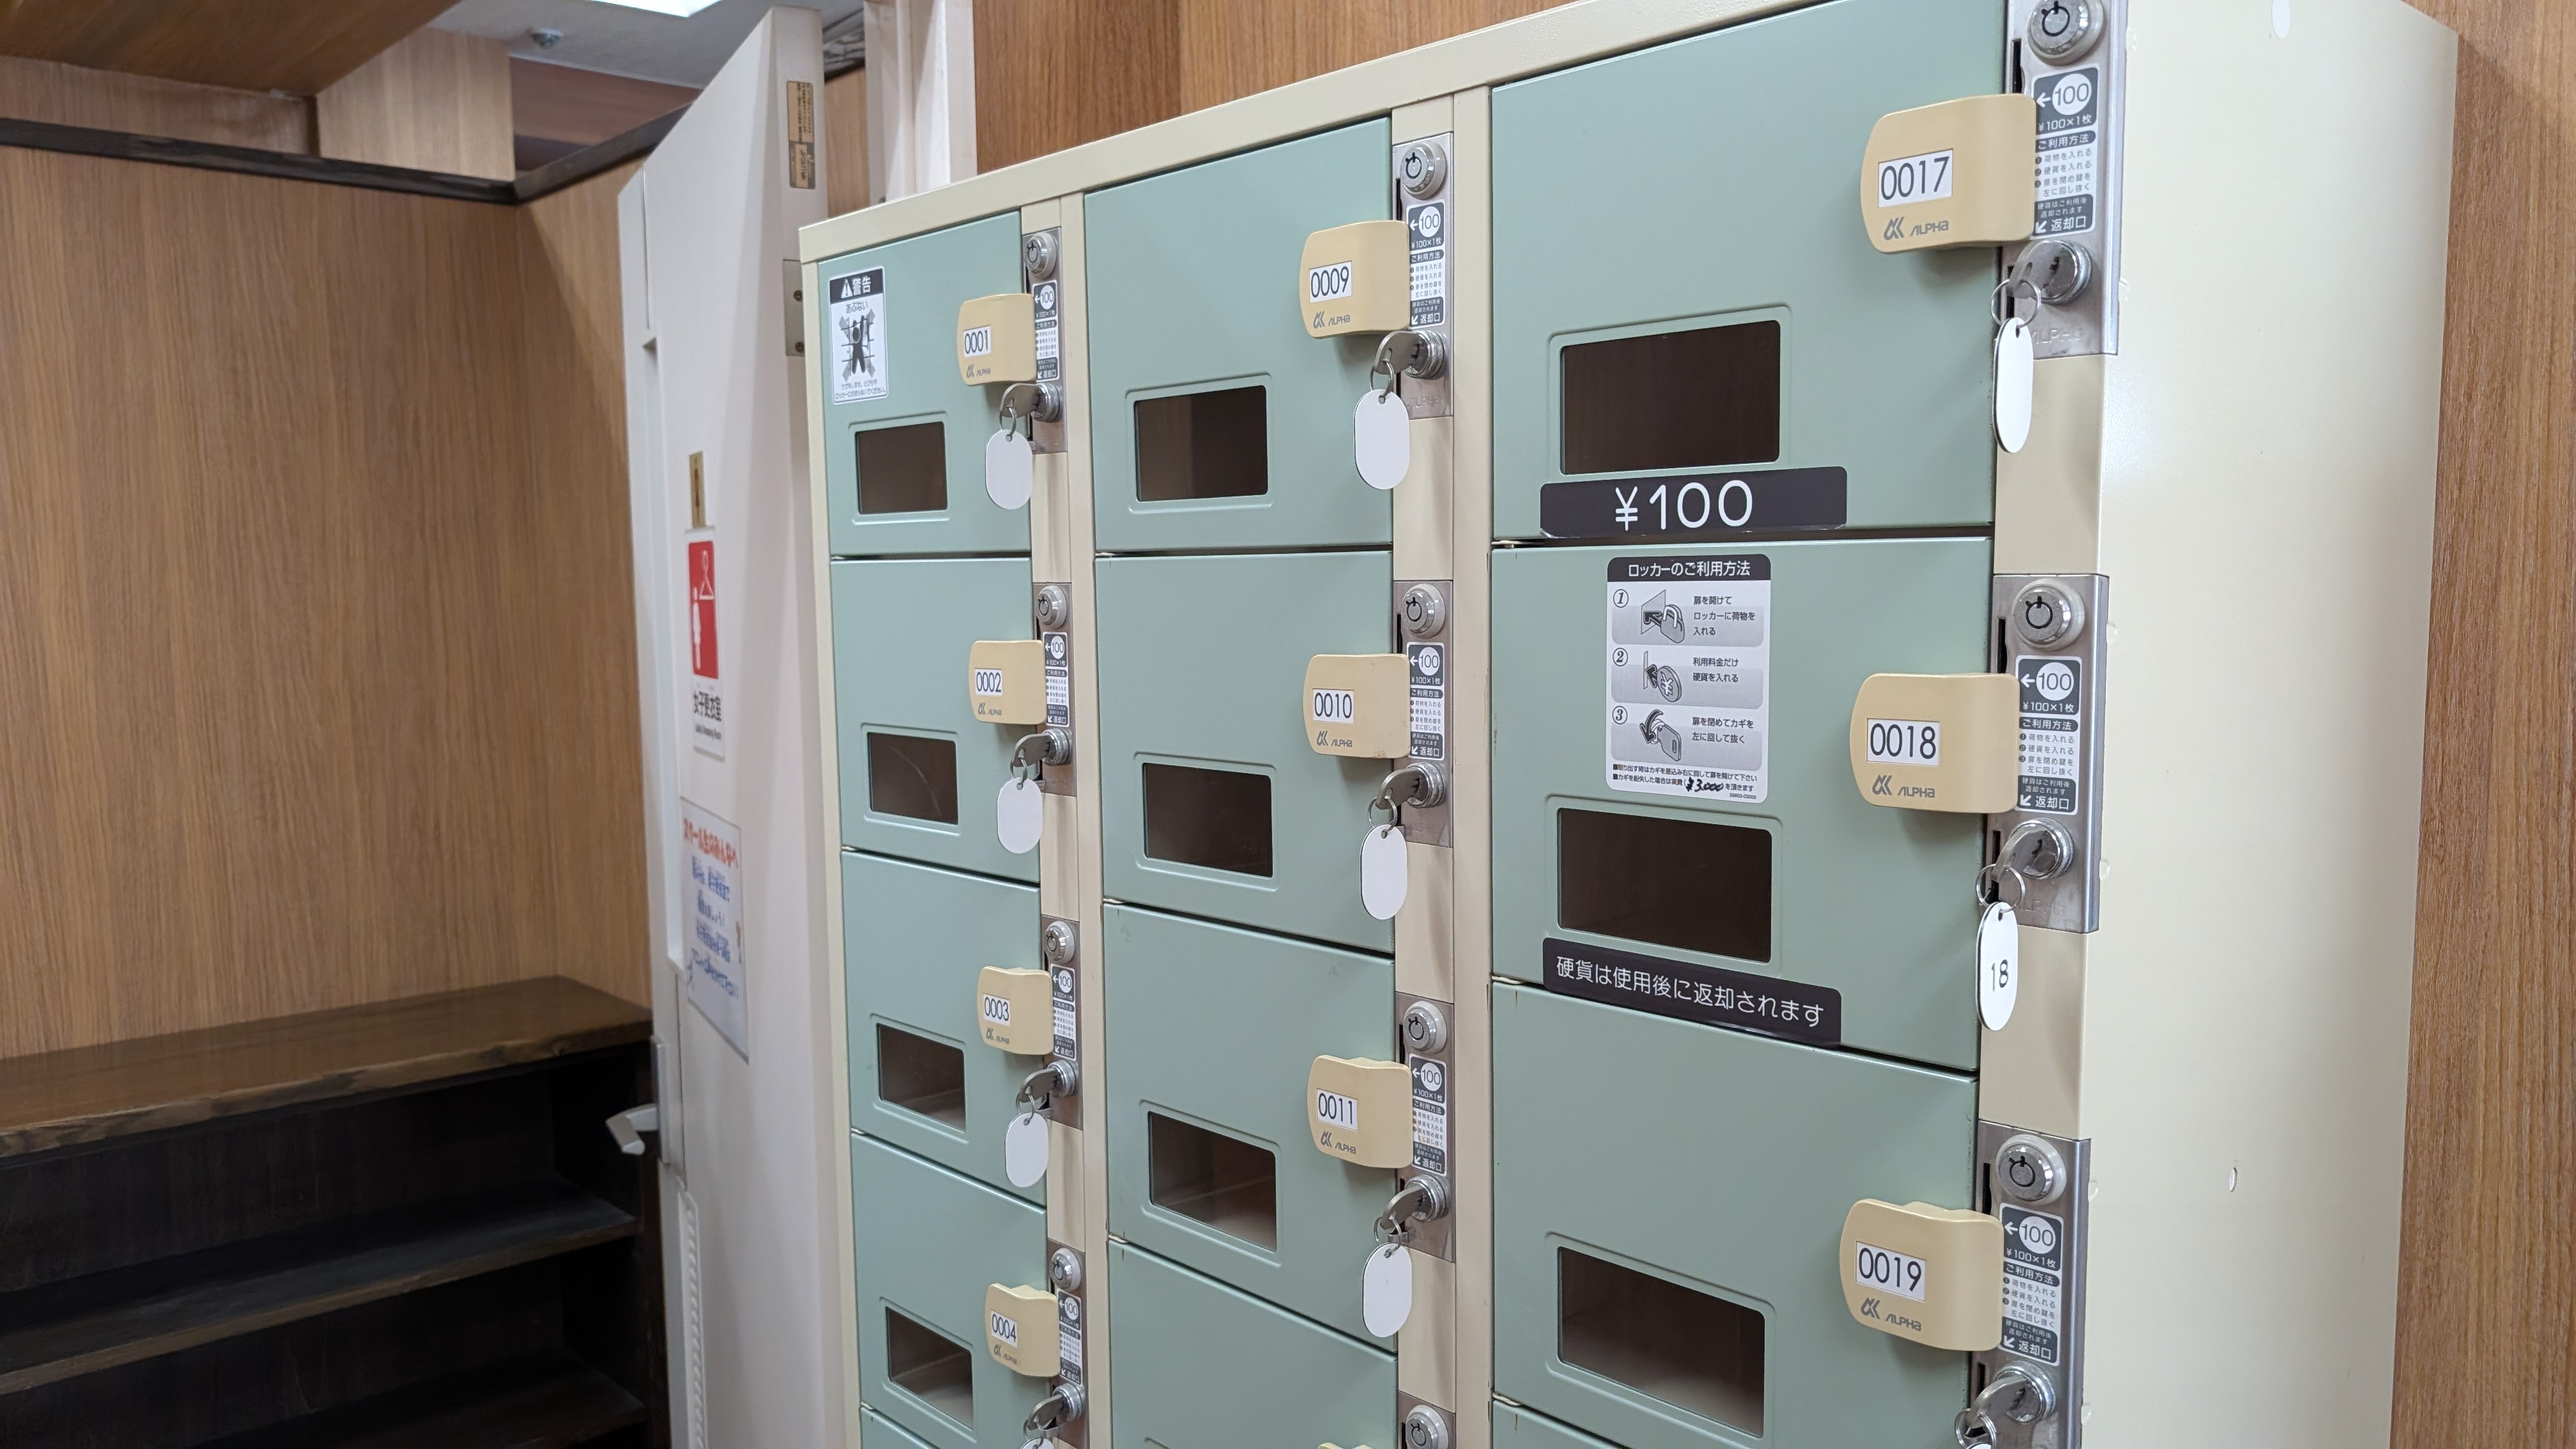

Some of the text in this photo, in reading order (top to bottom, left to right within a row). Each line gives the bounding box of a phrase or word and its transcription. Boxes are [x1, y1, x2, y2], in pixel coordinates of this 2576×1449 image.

[2055, 82, 2089, 106] 100
[2038, 133, 2089, 150] ご利用方法
[1881, 156, 1949, 201] 0017
[1420, 214, 1439, 231] 100
[2051, 216, 2087, 232] 返却口
[852, 275, 871, 296] 警告
[1311, 268, 1349, 298] 0009
[1042, 291, 1054, 303] 100
[965, 330, 988, 355] 0001
[1614, 479, 1752, 531] ¥100
[1629, 560, 1751, 577] ロッカーのご利用方法
[1694, 595, 1732, 605] 扉を開けて
[1694, 611, 1756, 620] ロッカーに荷物を
[1693, 627, 1716, 636] 入れる
[1052, 642, 1064, 653] 100
[1420, 654, 1438, 668] 100
[1693, 657, 1738, 667] 利用料金だけ
[976, 671, 1001, 693] 0002
[1693, 672, 1738, 682] 硬貨を入れる
[2038, 673, 2072, 691] 100
[1412, 689, 1439, 698] ご利用方法
[1314, 693, 1352, 719] 0010
[2022, 702, 2074, 714] ¥100×1枚
[1692, 717, 1754, 728] 扉を閉めてカギを
[2023, 719, 2072, 730] ご利用方法
[1692, 732, 1745, 744] 左に回して抜く
[1869, 723, 1936, 760] 0018
[2028, 733, 2074, 744] 荷物を入れる
[2028, 745, 2074, 755] 硬貨を入れる
[2035, 797, 2069, 810] 返却口
[1060, 976, 1071, 988] 100
[1991, 959, 2009, 992] 18
[1556, 956, 1824, 1027] 硬貨は使用後に返却されます
[985, 997, 1009, 1022] 0003
[1422, 1069, 1441, 1085] 100
[1319, 1093, 1353, 1124] 0011
[2021, 1224, 2054, 1246] 100
[2006, 1248, 2056, 1268] ¥100×1枚
[1859, 1247, 1922, 1291] 0019
[2006, 1264, 2053, 1285] ご利用方法
[1066, 1303, 1077, 1315] 100
[992, 1314, 1016, 1342] 0004
[2018, 1340, 2051, 1360] 返却口
